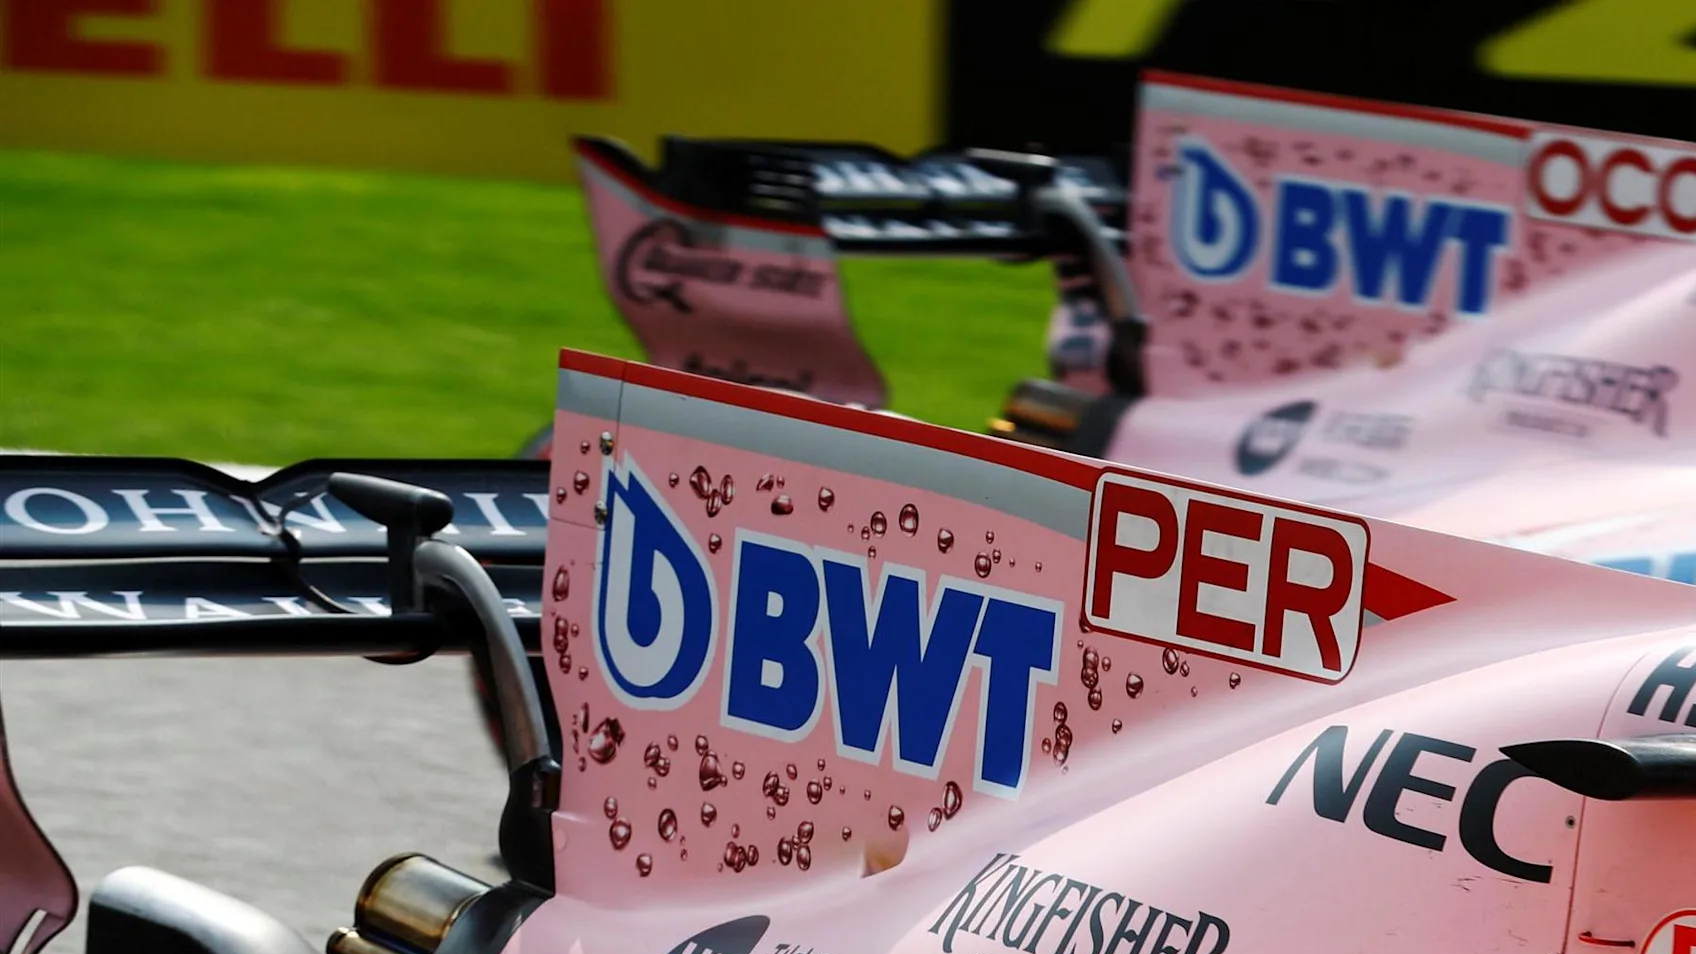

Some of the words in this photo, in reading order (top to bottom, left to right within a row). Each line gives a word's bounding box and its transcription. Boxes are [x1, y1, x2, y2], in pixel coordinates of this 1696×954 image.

[1272, 178, 1510, 316] BWT
[1093, 483, 1355, 672] PER
[728, 540, 1056, 790] BWT
[1266, 725, 1554, 884] NEC
